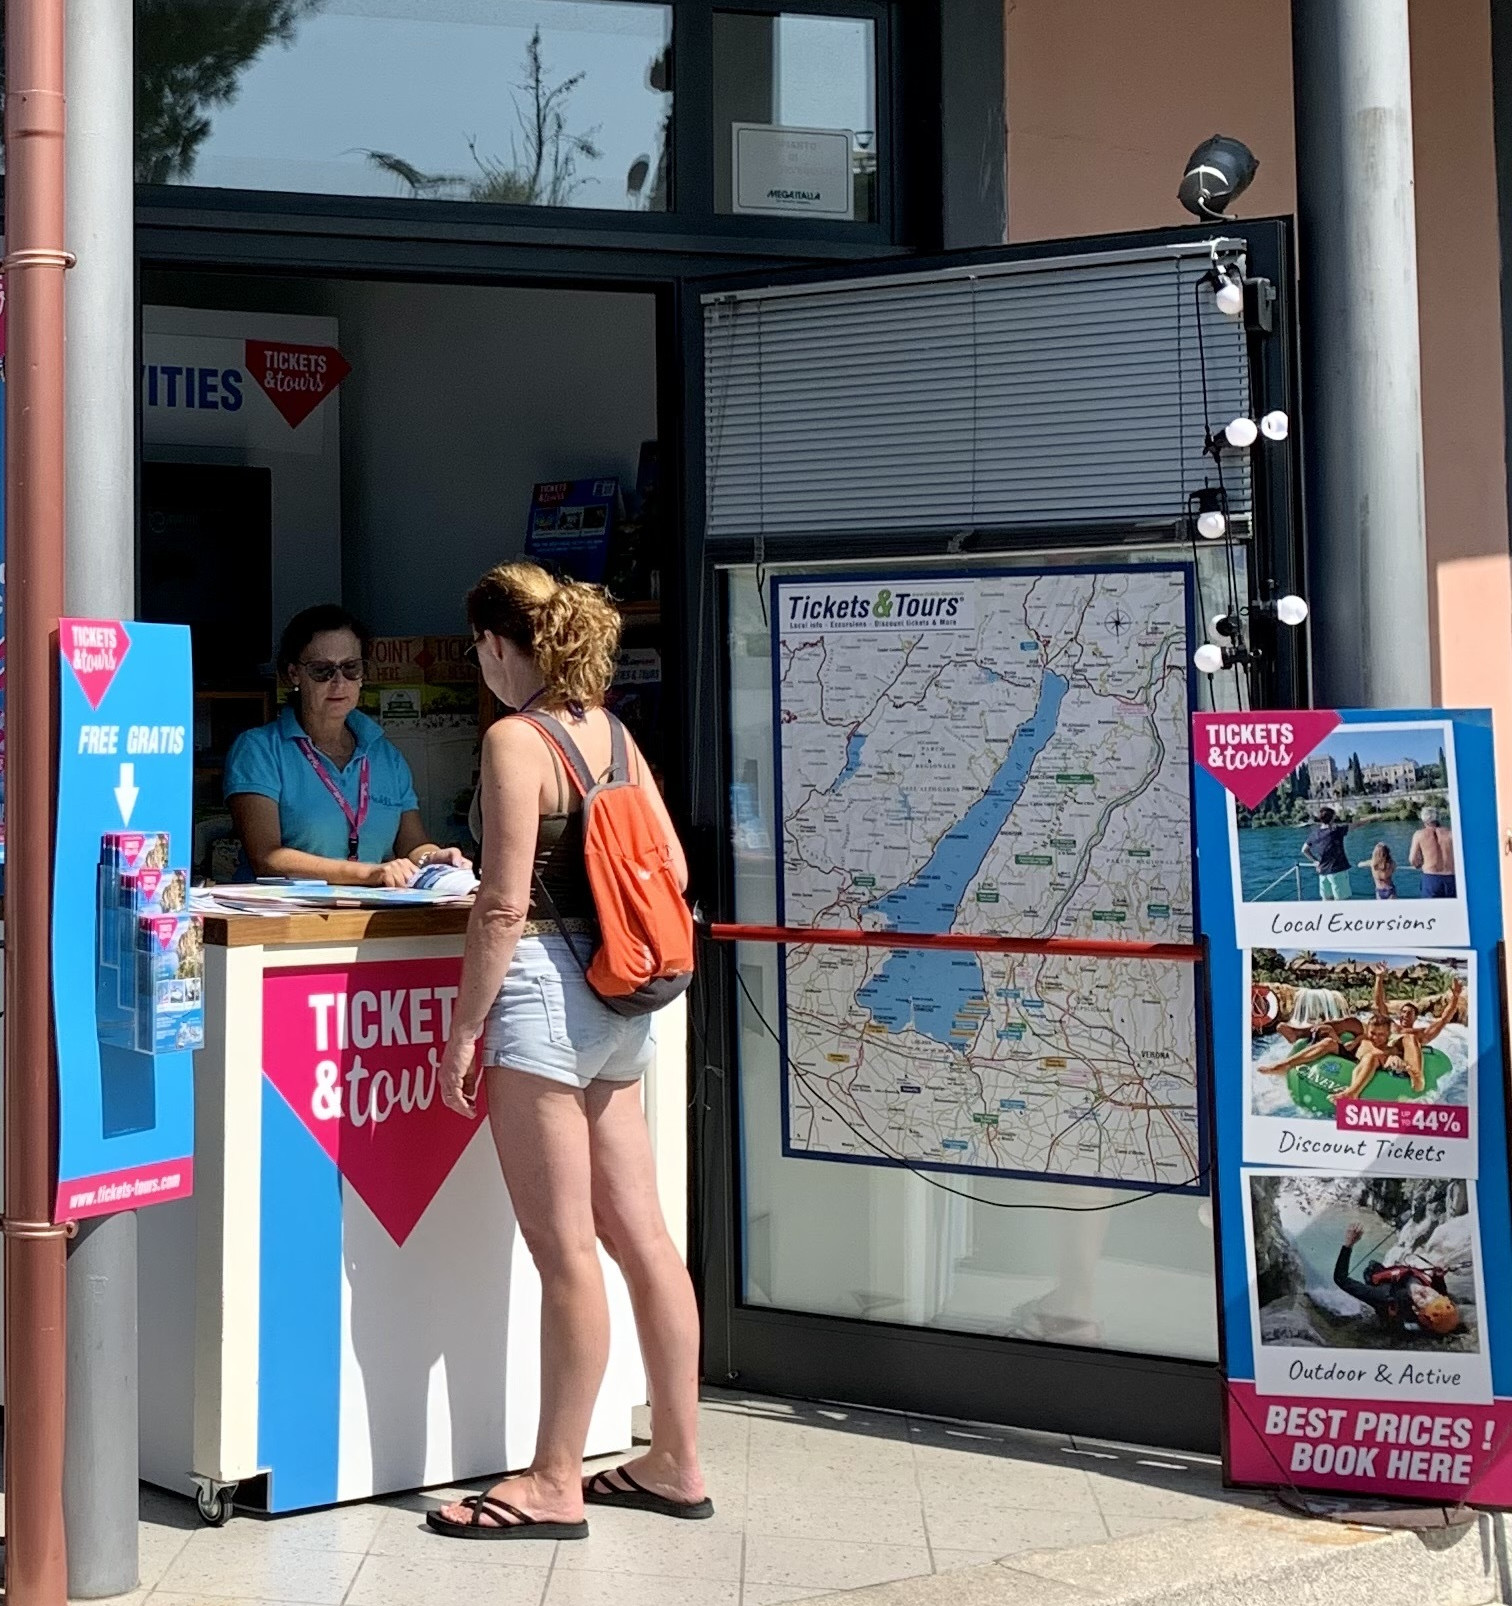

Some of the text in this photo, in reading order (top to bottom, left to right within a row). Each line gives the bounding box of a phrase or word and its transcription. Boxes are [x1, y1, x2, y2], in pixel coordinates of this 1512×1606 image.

[264, 351, 327, 373] TICKETS
[144, 365, 243, 412] ITIES
[264, 371, 325, 392] &tours
[874, 619, 904, 627] Discount
[72, 626, 117, 648] TICKETS
[72, 648, 117, 673] &tours
[434, 640, 474, 663] TICK
[78, 725, 185, 754] FREE GRATIS
[1206, 723, 1294, 745] TICKETS
[1208, 743, 1293, 770] &tours
[1271, 912, 1436, 934] Local Excursions
[308, 986, 459, 1051] TICKET
[1141, 1051, 1169, 1060] VERONA
[311, 1047, 442, 1128] &tou
[1345, 1104, 1400, 1128] SAVE
[1412, 1109, 1461, 1132] 44%
[1278, 1130, 1445, 1162] Discount Tickets
[69, 1174, 181, 1209] www.tickets-tours.com
[1289, 1359, 1461, 1385] Outdoor & Active
[1265, 1405, 1496, 1451] BEST PRICES !
[1290, 1442, 1473, 1485] BOOK HERE
